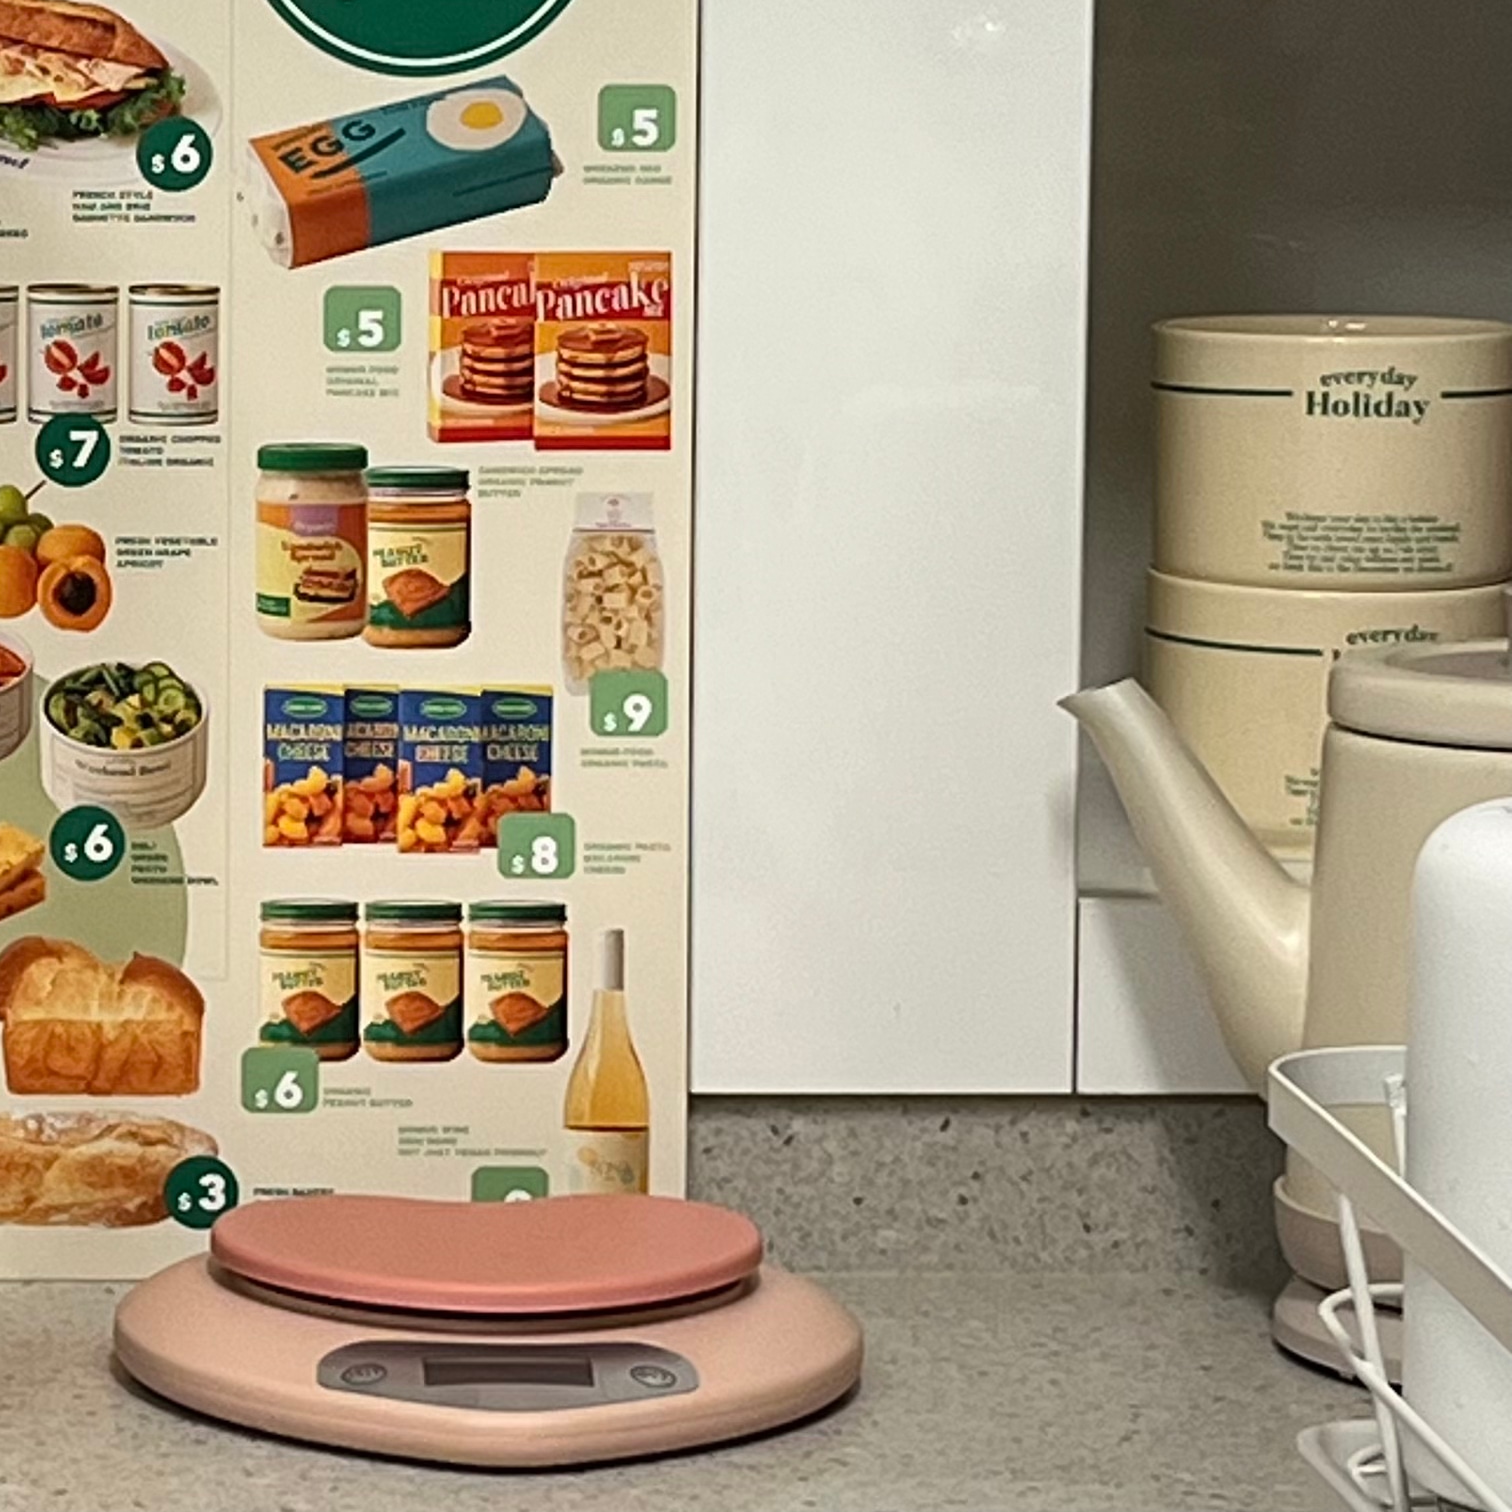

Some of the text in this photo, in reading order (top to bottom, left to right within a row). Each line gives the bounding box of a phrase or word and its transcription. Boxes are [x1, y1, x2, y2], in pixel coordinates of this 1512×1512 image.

[278, 119, 376, 175] EGG
[442, 270, 535, 319] Panca
[537, 271, 669, 322] Pancake
[1320, 366, 1418, 392] everyday
[1305, 390, 1430, 425] Holiday
